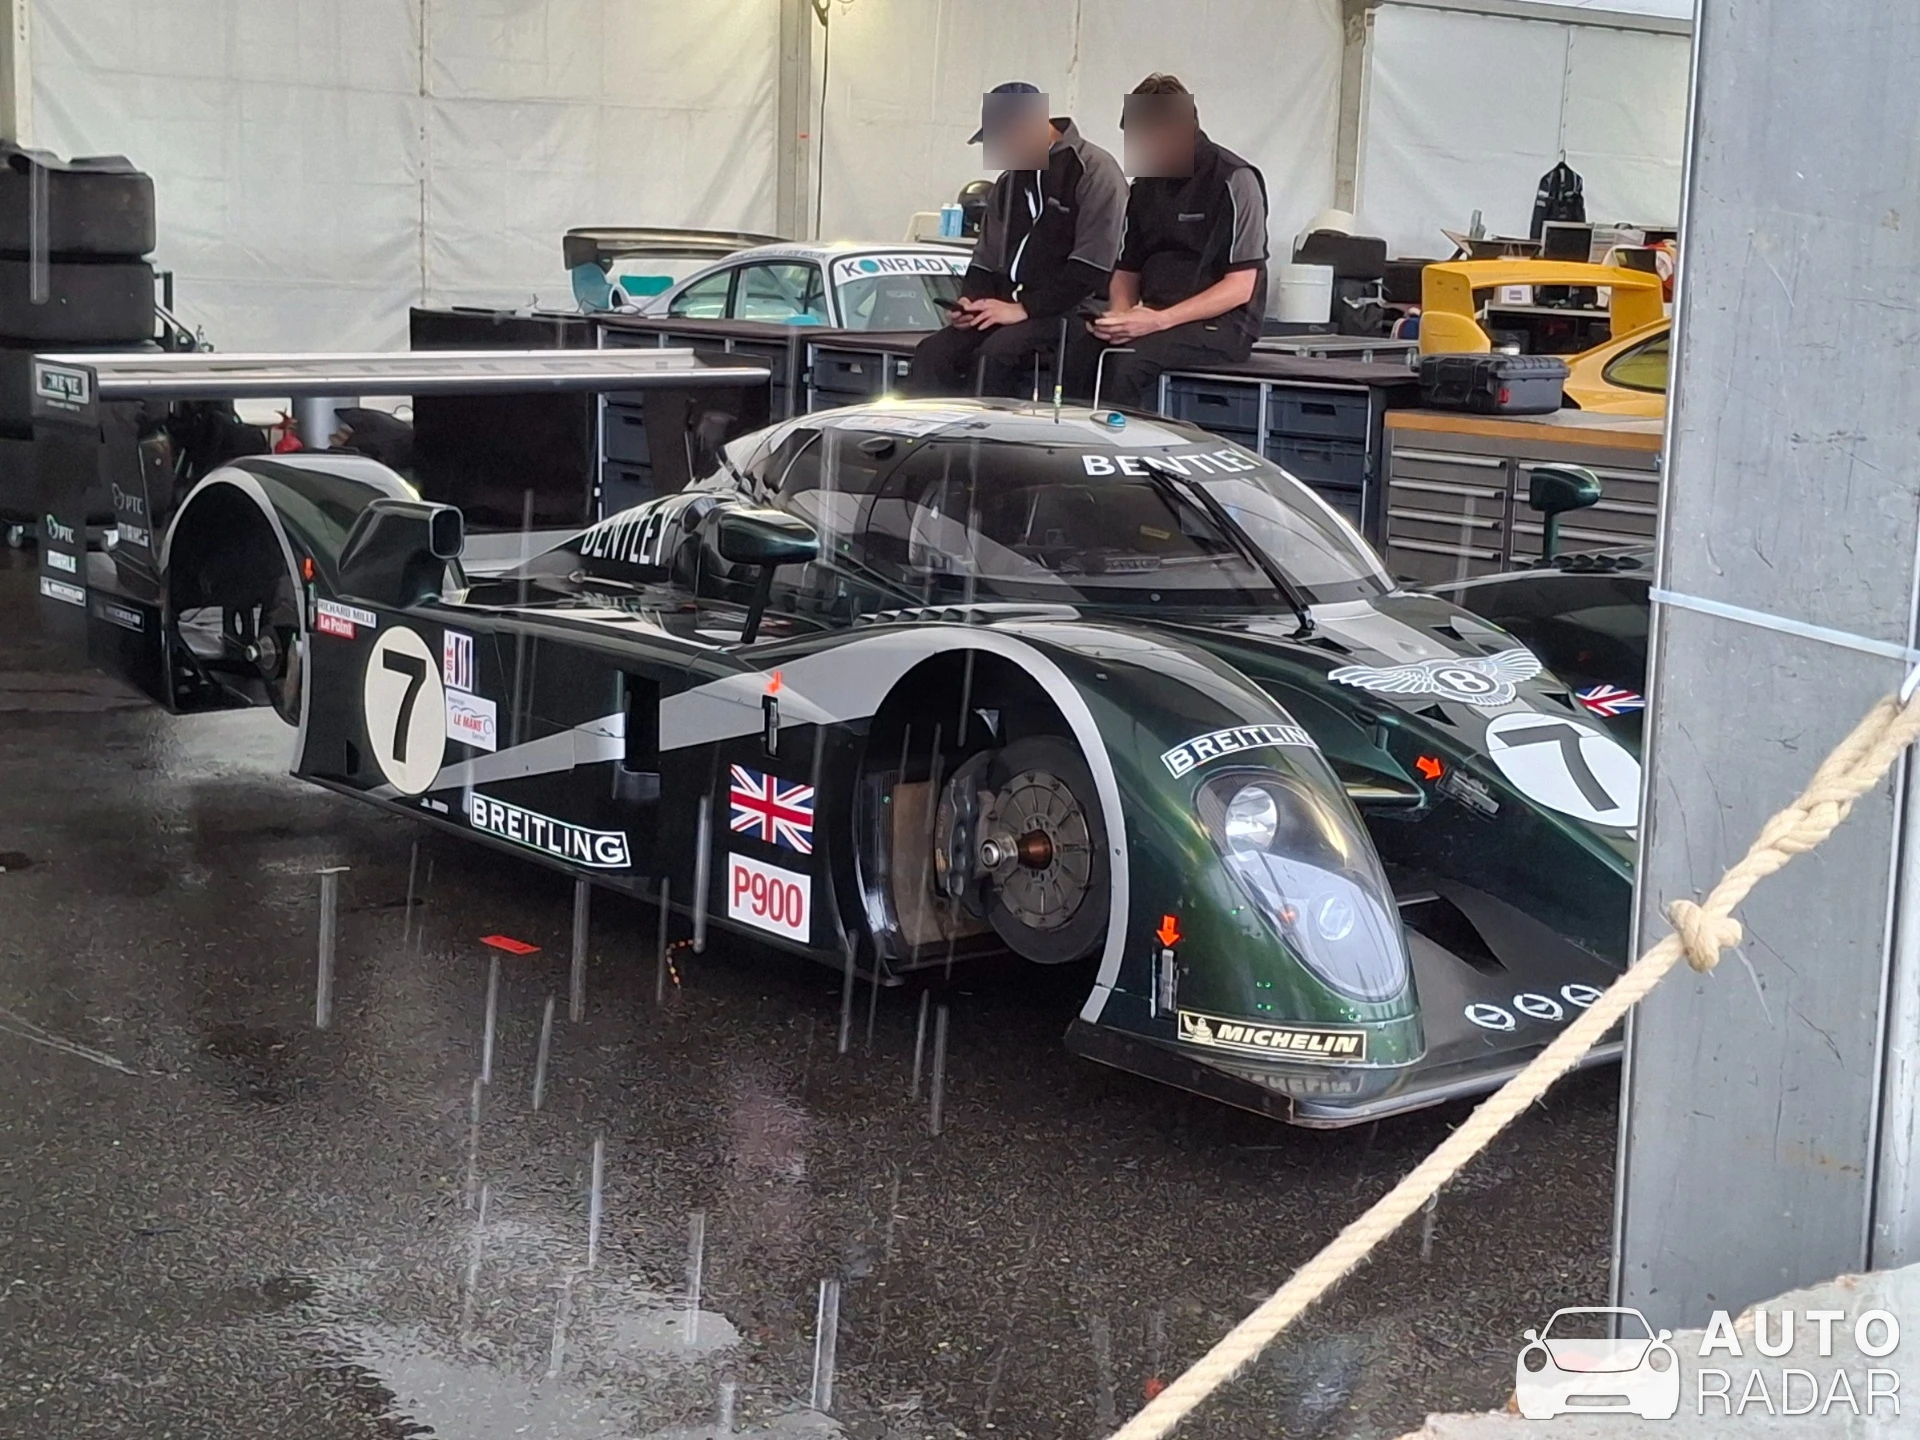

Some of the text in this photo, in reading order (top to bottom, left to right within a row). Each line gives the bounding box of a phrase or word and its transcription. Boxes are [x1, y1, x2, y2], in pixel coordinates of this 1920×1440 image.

[840, 256, 946, 278] KONRAD
[1081, 448, 1263, 476] BENTLEY
[125, 495, 144, 514] PTC
[58, 525, 74, 544] PTC
[580, 506, 680, 567] BENTLEY
[318, 600, 350, 618] RICHARD
[320, 614, 353, 637] Le Point
[445, 634, 454, 684] IMSA
[382, 647, 427, 765] 7
[453, 713, 483, 732] LE MANS
[1493, 723, 1621, 812] 7
[472, 796, 625, 864] BREITLING
[734, 864, 804, 928] P900
[1216, 1023, 1359, 1053] MICHELIN
